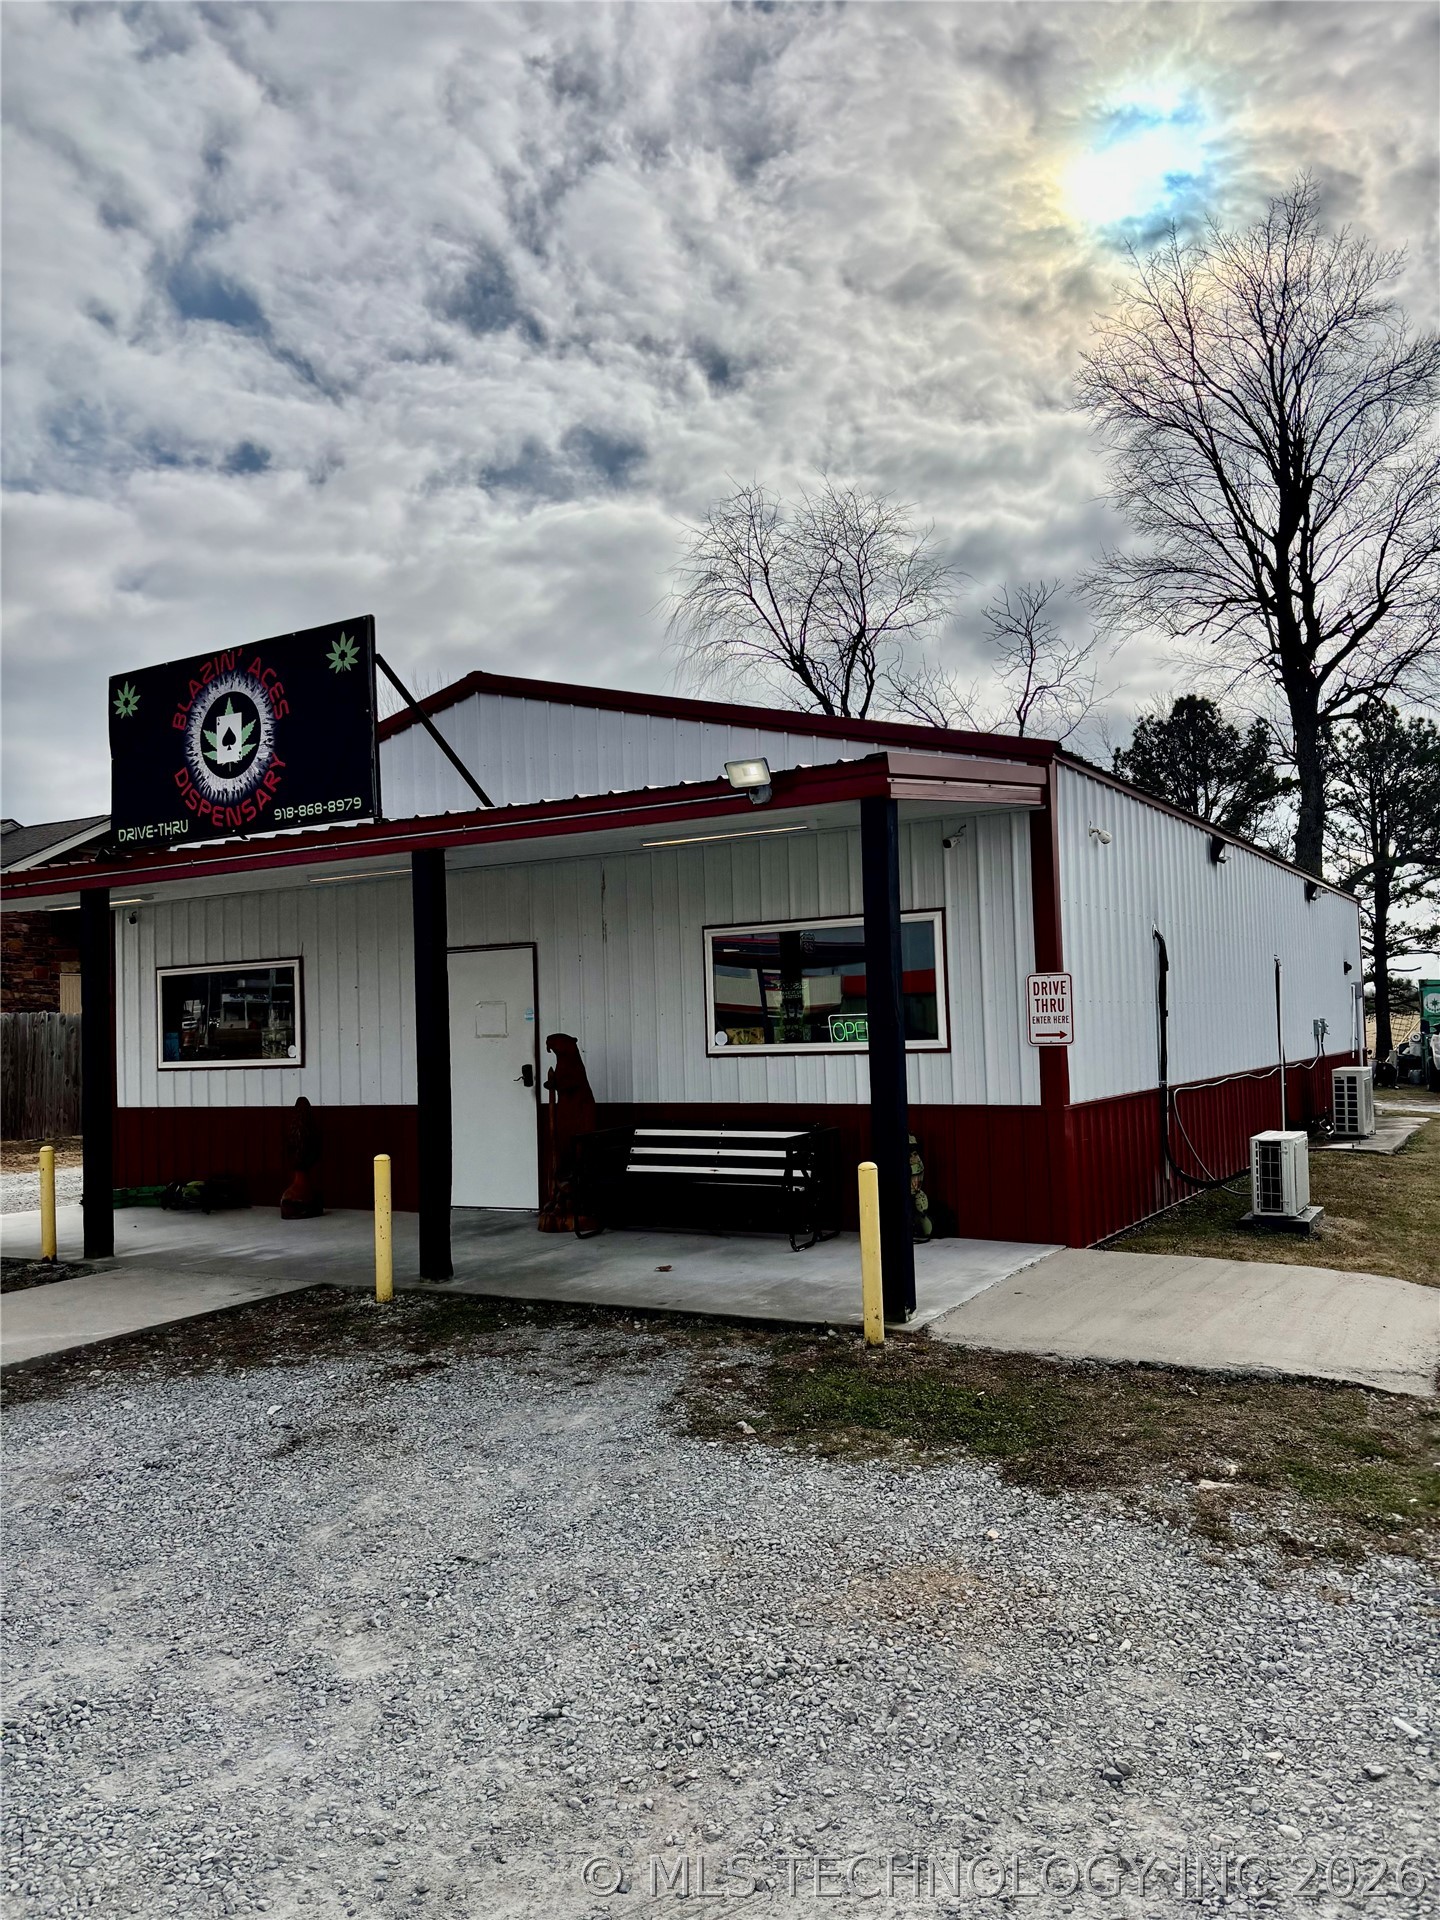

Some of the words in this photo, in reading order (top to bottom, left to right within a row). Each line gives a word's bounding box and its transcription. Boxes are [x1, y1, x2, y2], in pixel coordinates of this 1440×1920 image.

[172, 648, 243, 731] BLAZIN'
[247, 656, 290, 720] ACES
[174, 752, 286, 827] DISPENSARY
[273, 797, 362, 821] 918-868-8979
[118, 819, 189, 842] DRIVE-THRU
[1033, 980, 1067, 996] DRIVE
[1035, 998, 1065, 1013] THRU
[1032, 1016, 1051, 1024] ENTER
[1053, 1015, 1069, 1024] HERE
